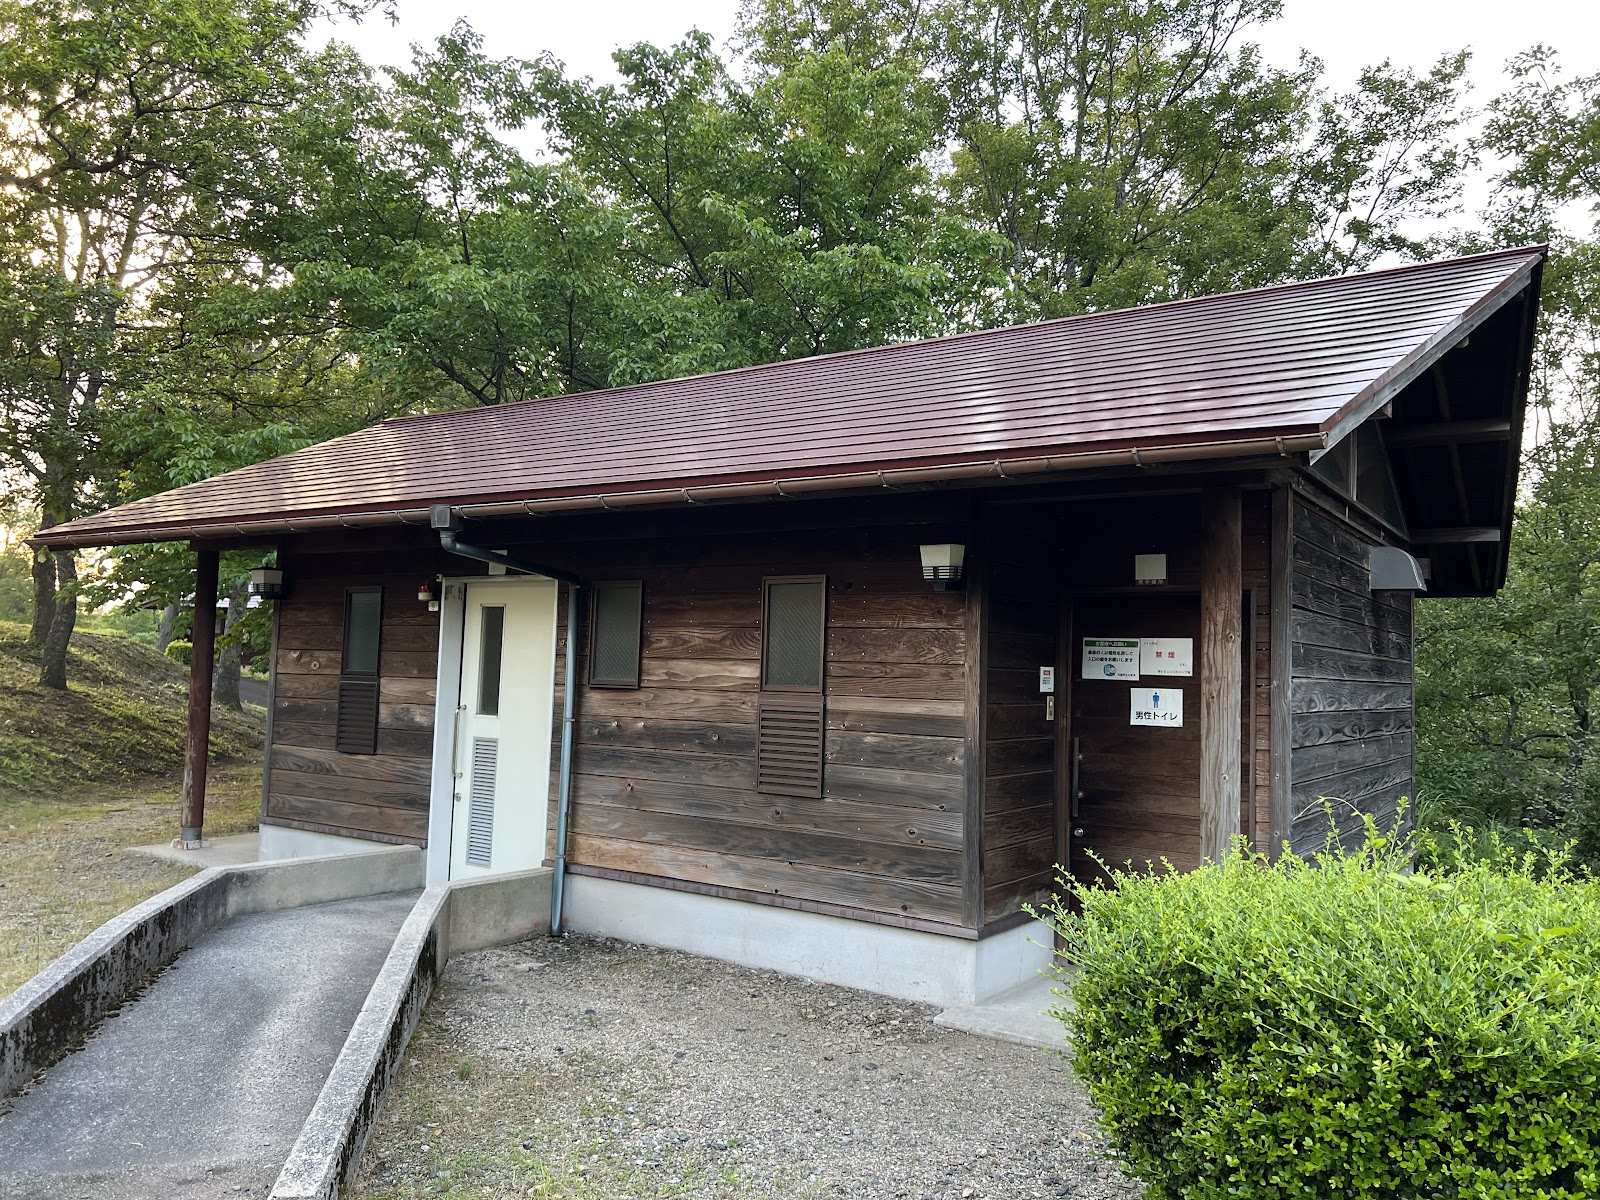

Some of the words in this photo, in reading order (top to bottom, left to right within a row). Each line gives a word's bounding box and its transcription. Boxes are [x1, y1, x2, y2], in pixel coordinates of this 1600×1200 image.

[1135, 711, 1178, 721] 男性トイレ
